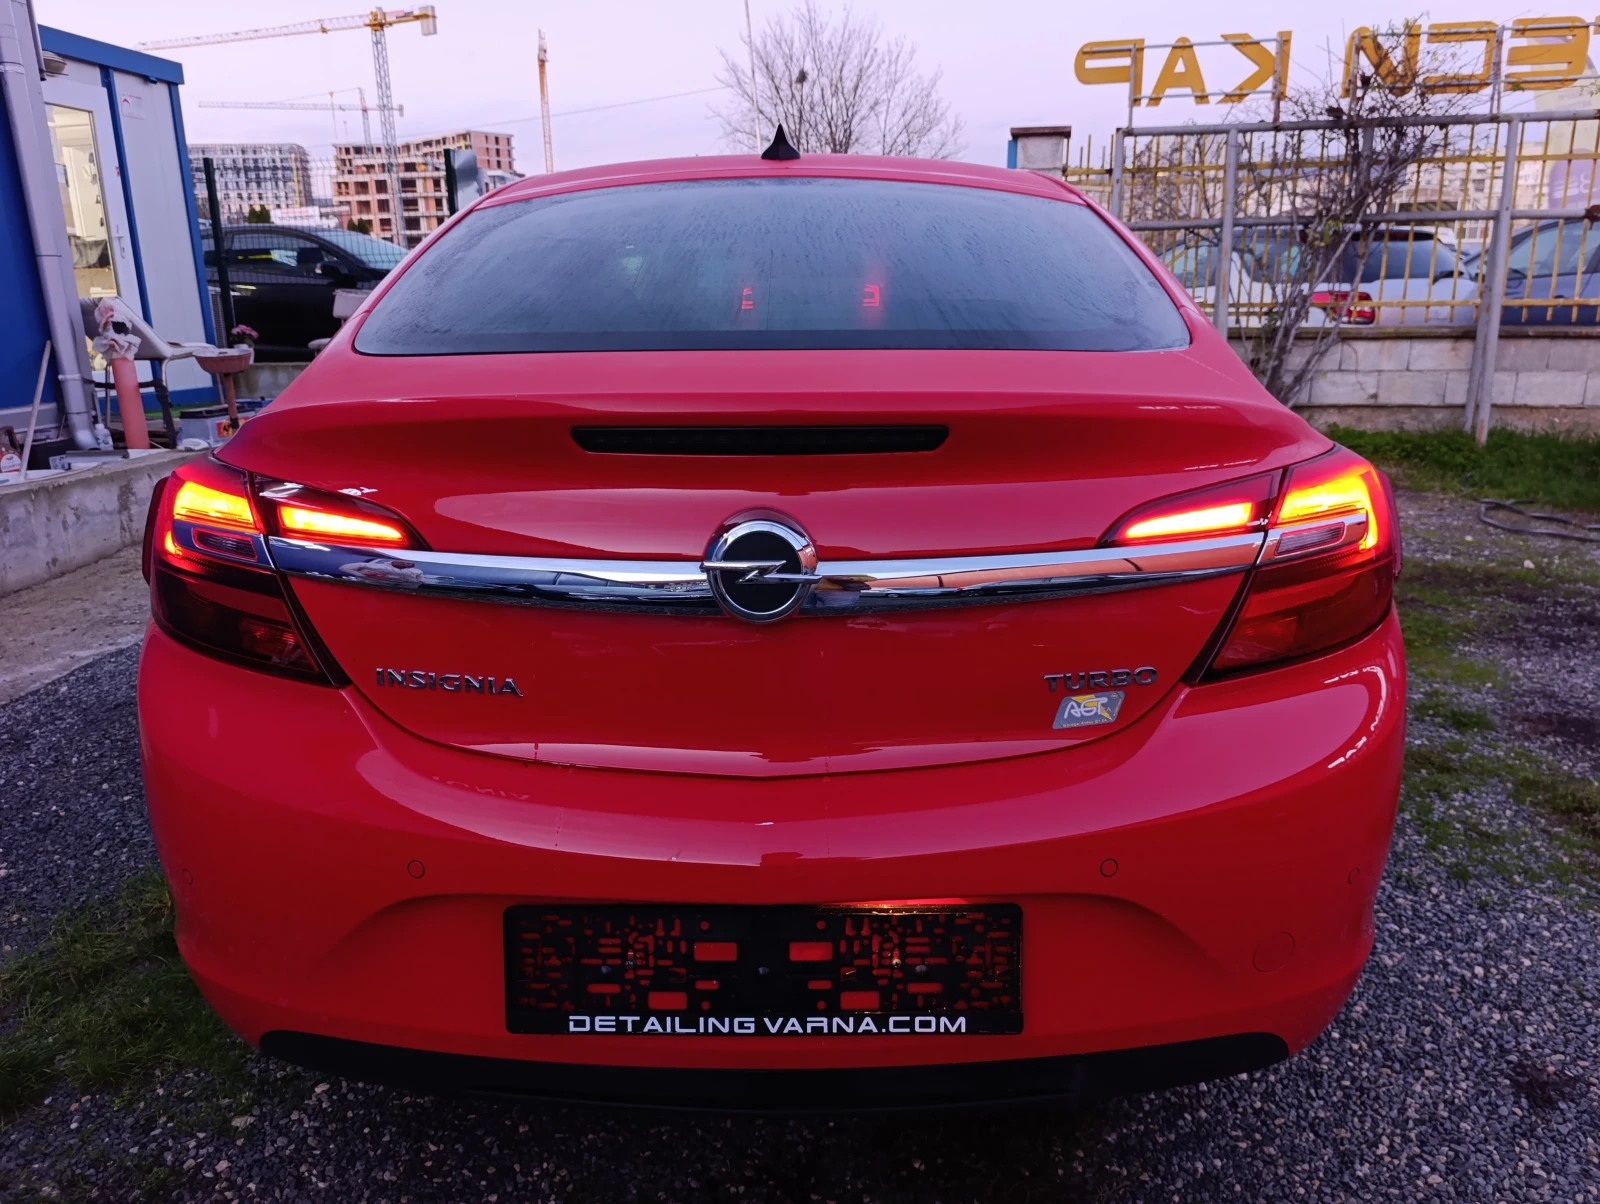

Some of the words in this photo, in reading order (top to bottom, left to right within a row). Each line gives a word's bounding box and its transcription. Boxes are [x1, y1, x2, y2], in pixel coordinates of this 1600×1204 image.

[376, 667, 524, 697] INSIGNIA
[1043, 666, 1157, 691] TURBO
[569, 1016, 755, 1033] DETAILING
[763, 1016, 966, 1033] VARNA.COM
